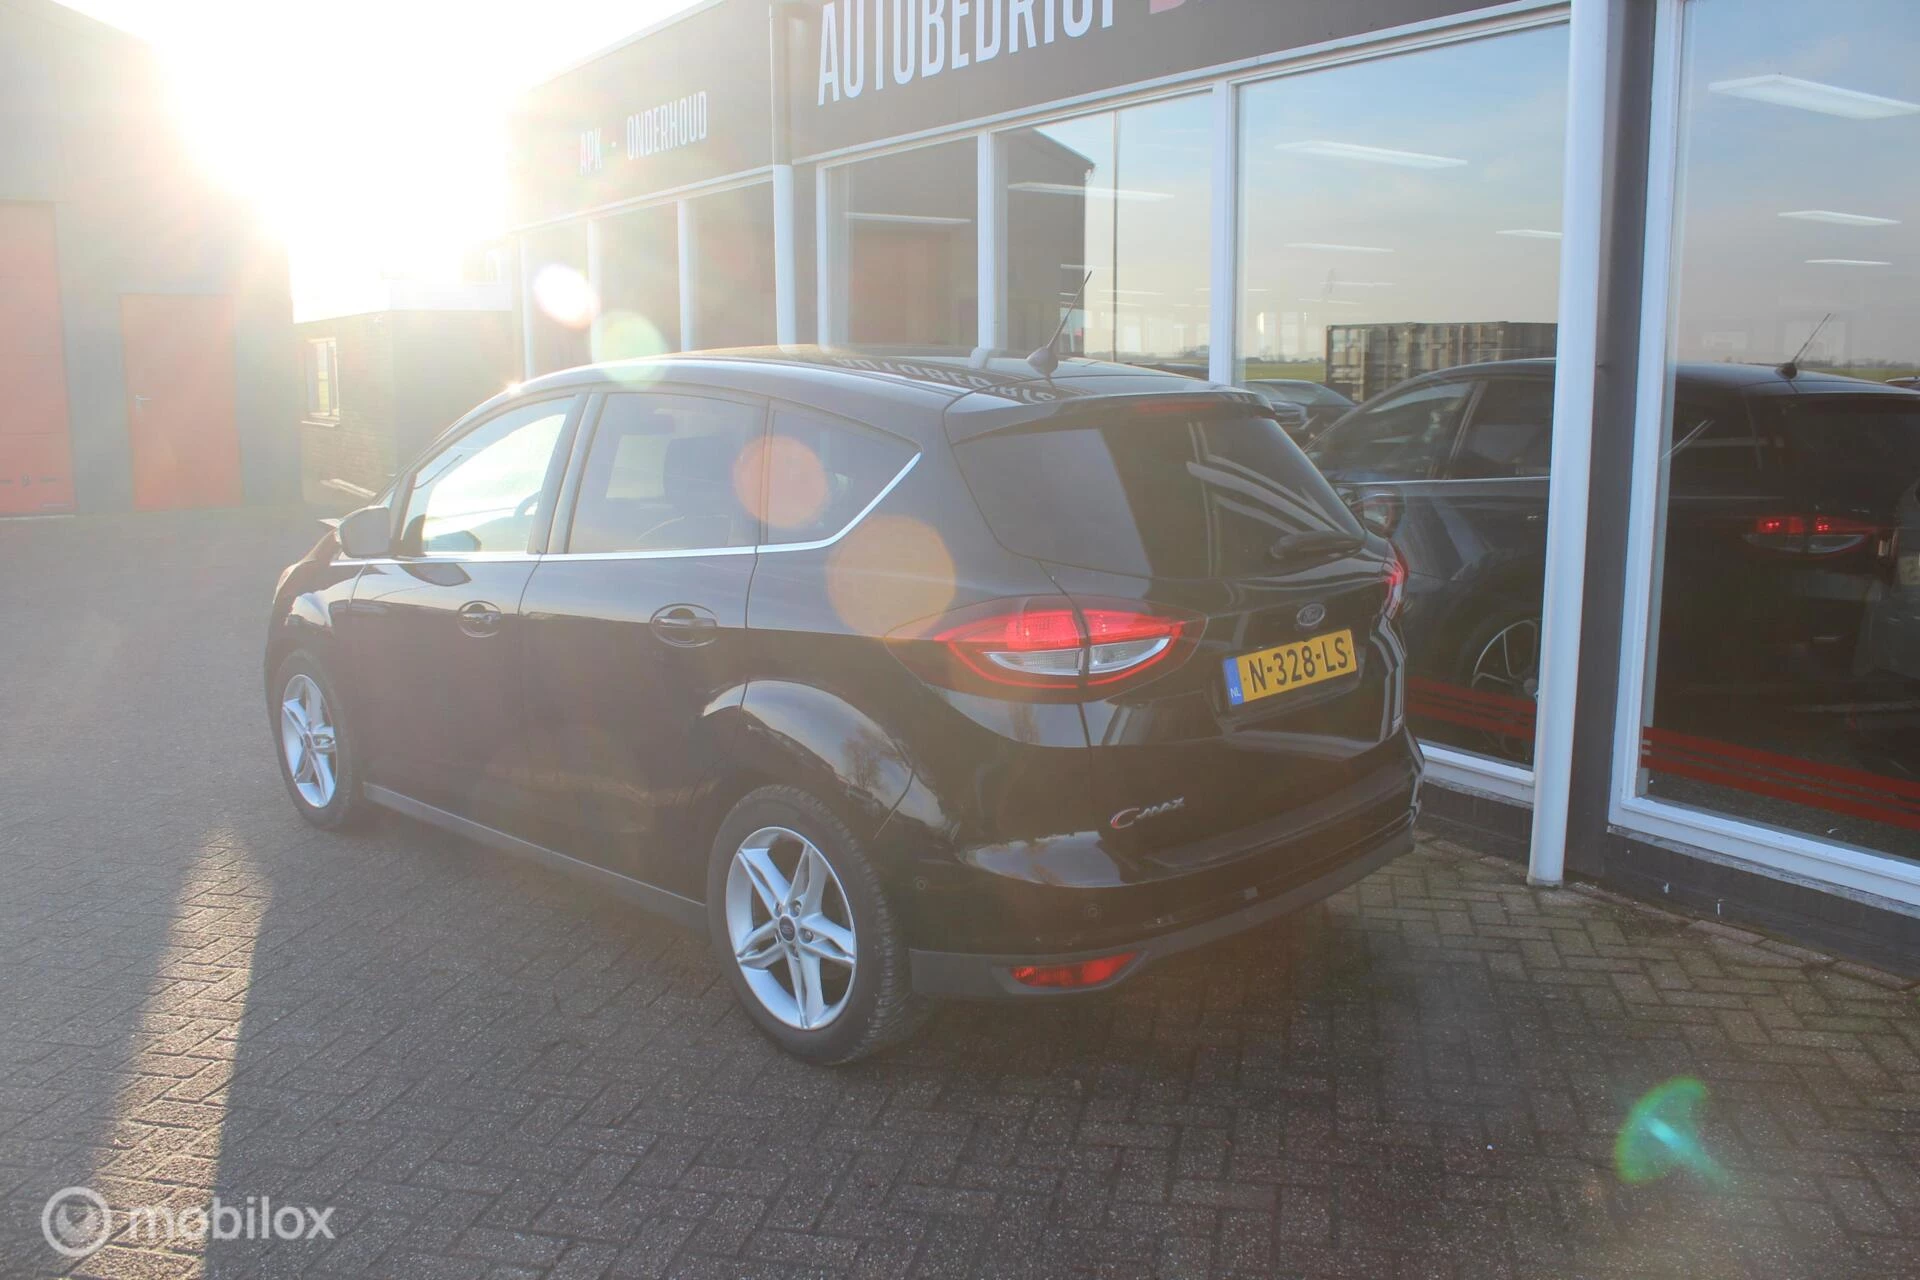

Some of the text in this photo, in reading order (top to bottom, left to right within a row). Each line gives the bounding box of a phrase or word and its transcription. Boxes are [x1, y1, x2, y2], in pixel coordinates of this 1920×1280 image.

[817, 0, 1113, 106] AUTOBED
[626, 91, 708, 161] ONDERHOUD
[1230, 687, 1241, 698] NL
[1249, 637, 1349, 693] N-328-LS
